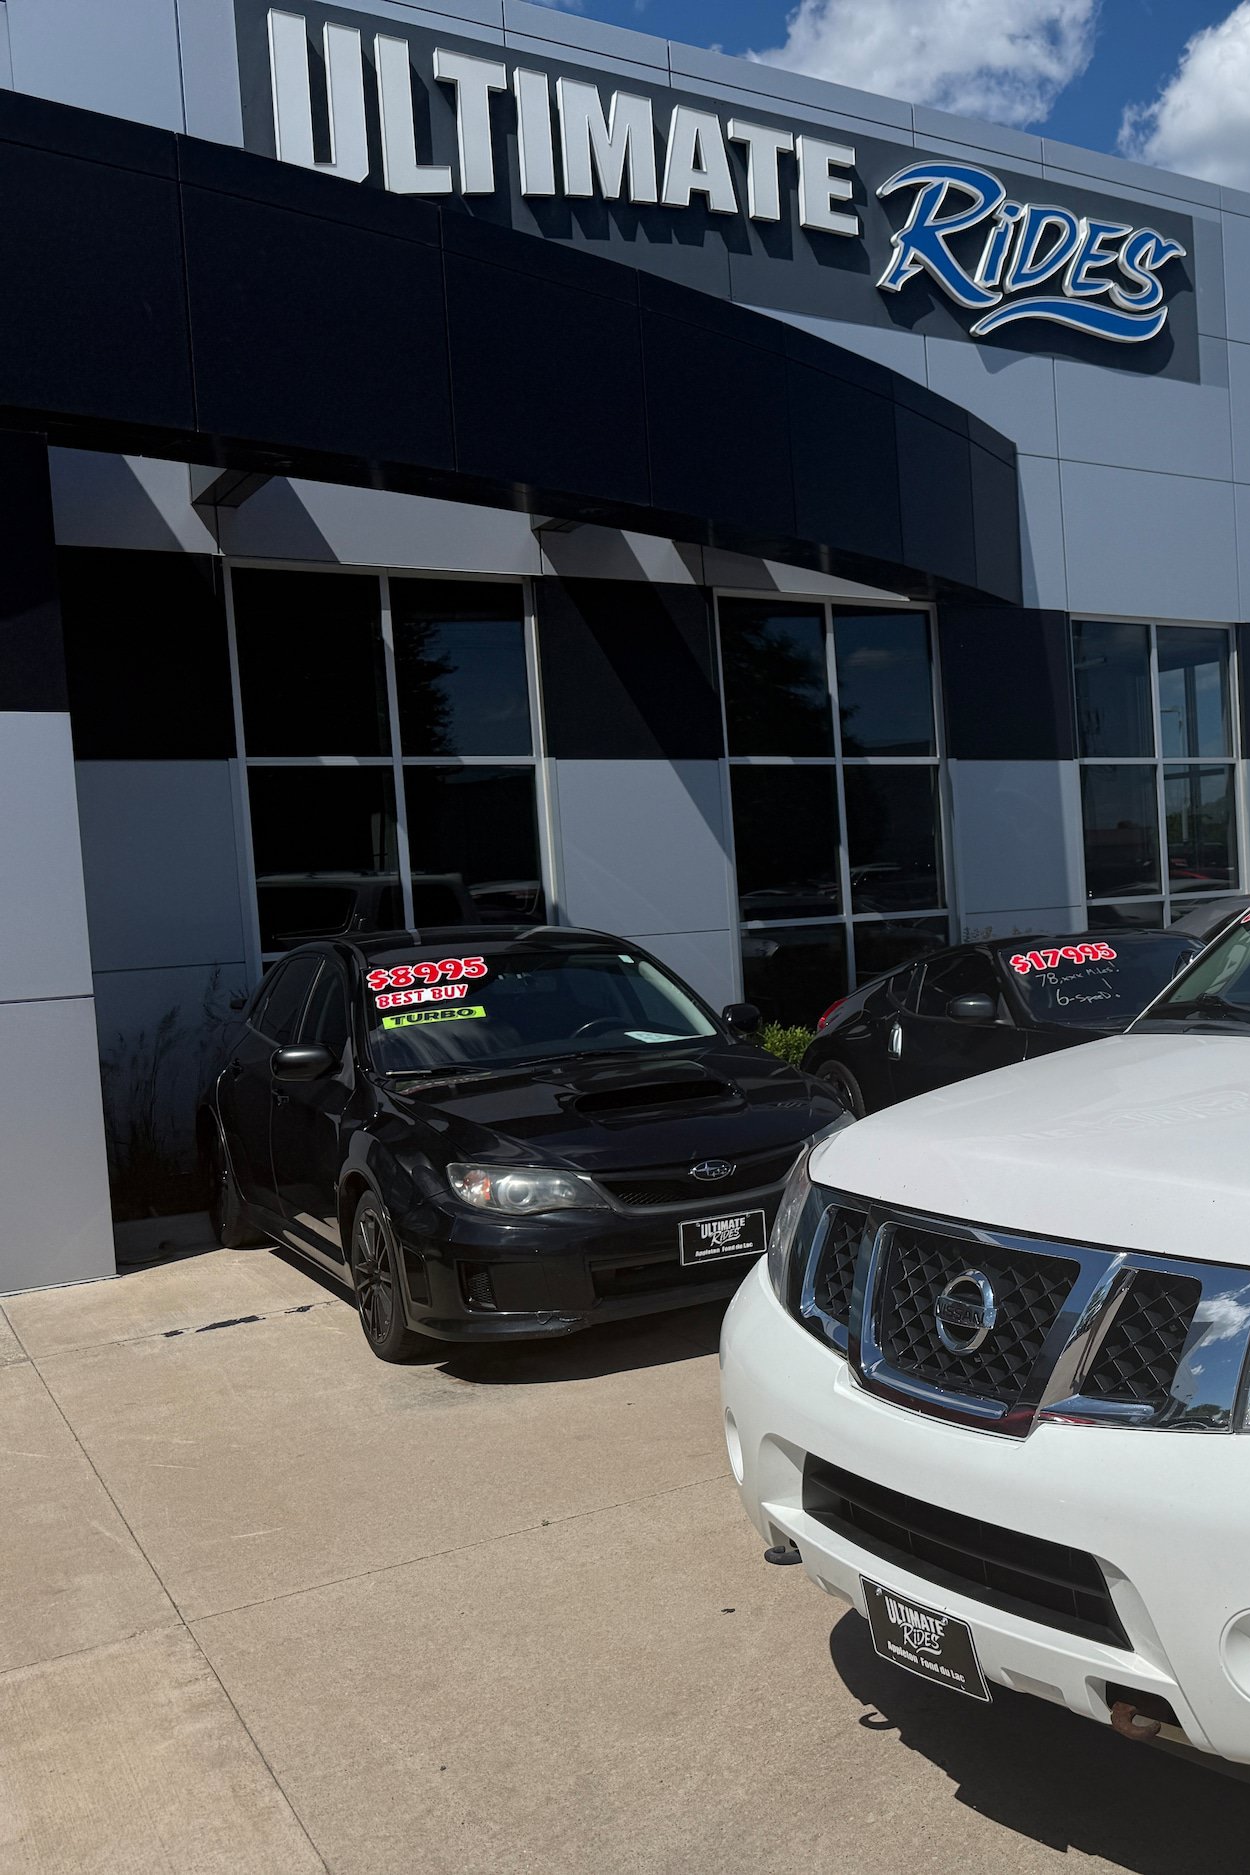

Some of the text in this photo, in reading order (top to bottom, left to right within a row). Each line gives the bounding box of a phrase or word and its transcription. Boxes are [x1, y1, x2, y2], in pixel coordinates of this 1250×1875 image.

[267, 8, 859, 237] ULTIMATE
[366, 956, 488, 991] $8995
[1009, 942, 1117, 975] $17995
[375, 984, 468, 1009] BEST BUY
[390, 1008, 475, 1026] TURBO
[701, 1217, 746, 1239] ULTIMATE
[695, 1247, 721, 1257] Appleton
[722, 1245, 735, 1253] Fond
[885, 1595, 946, 1637] ULTIMATE
[887, 1640, 966, 1683] Appleton Fond du Lac
